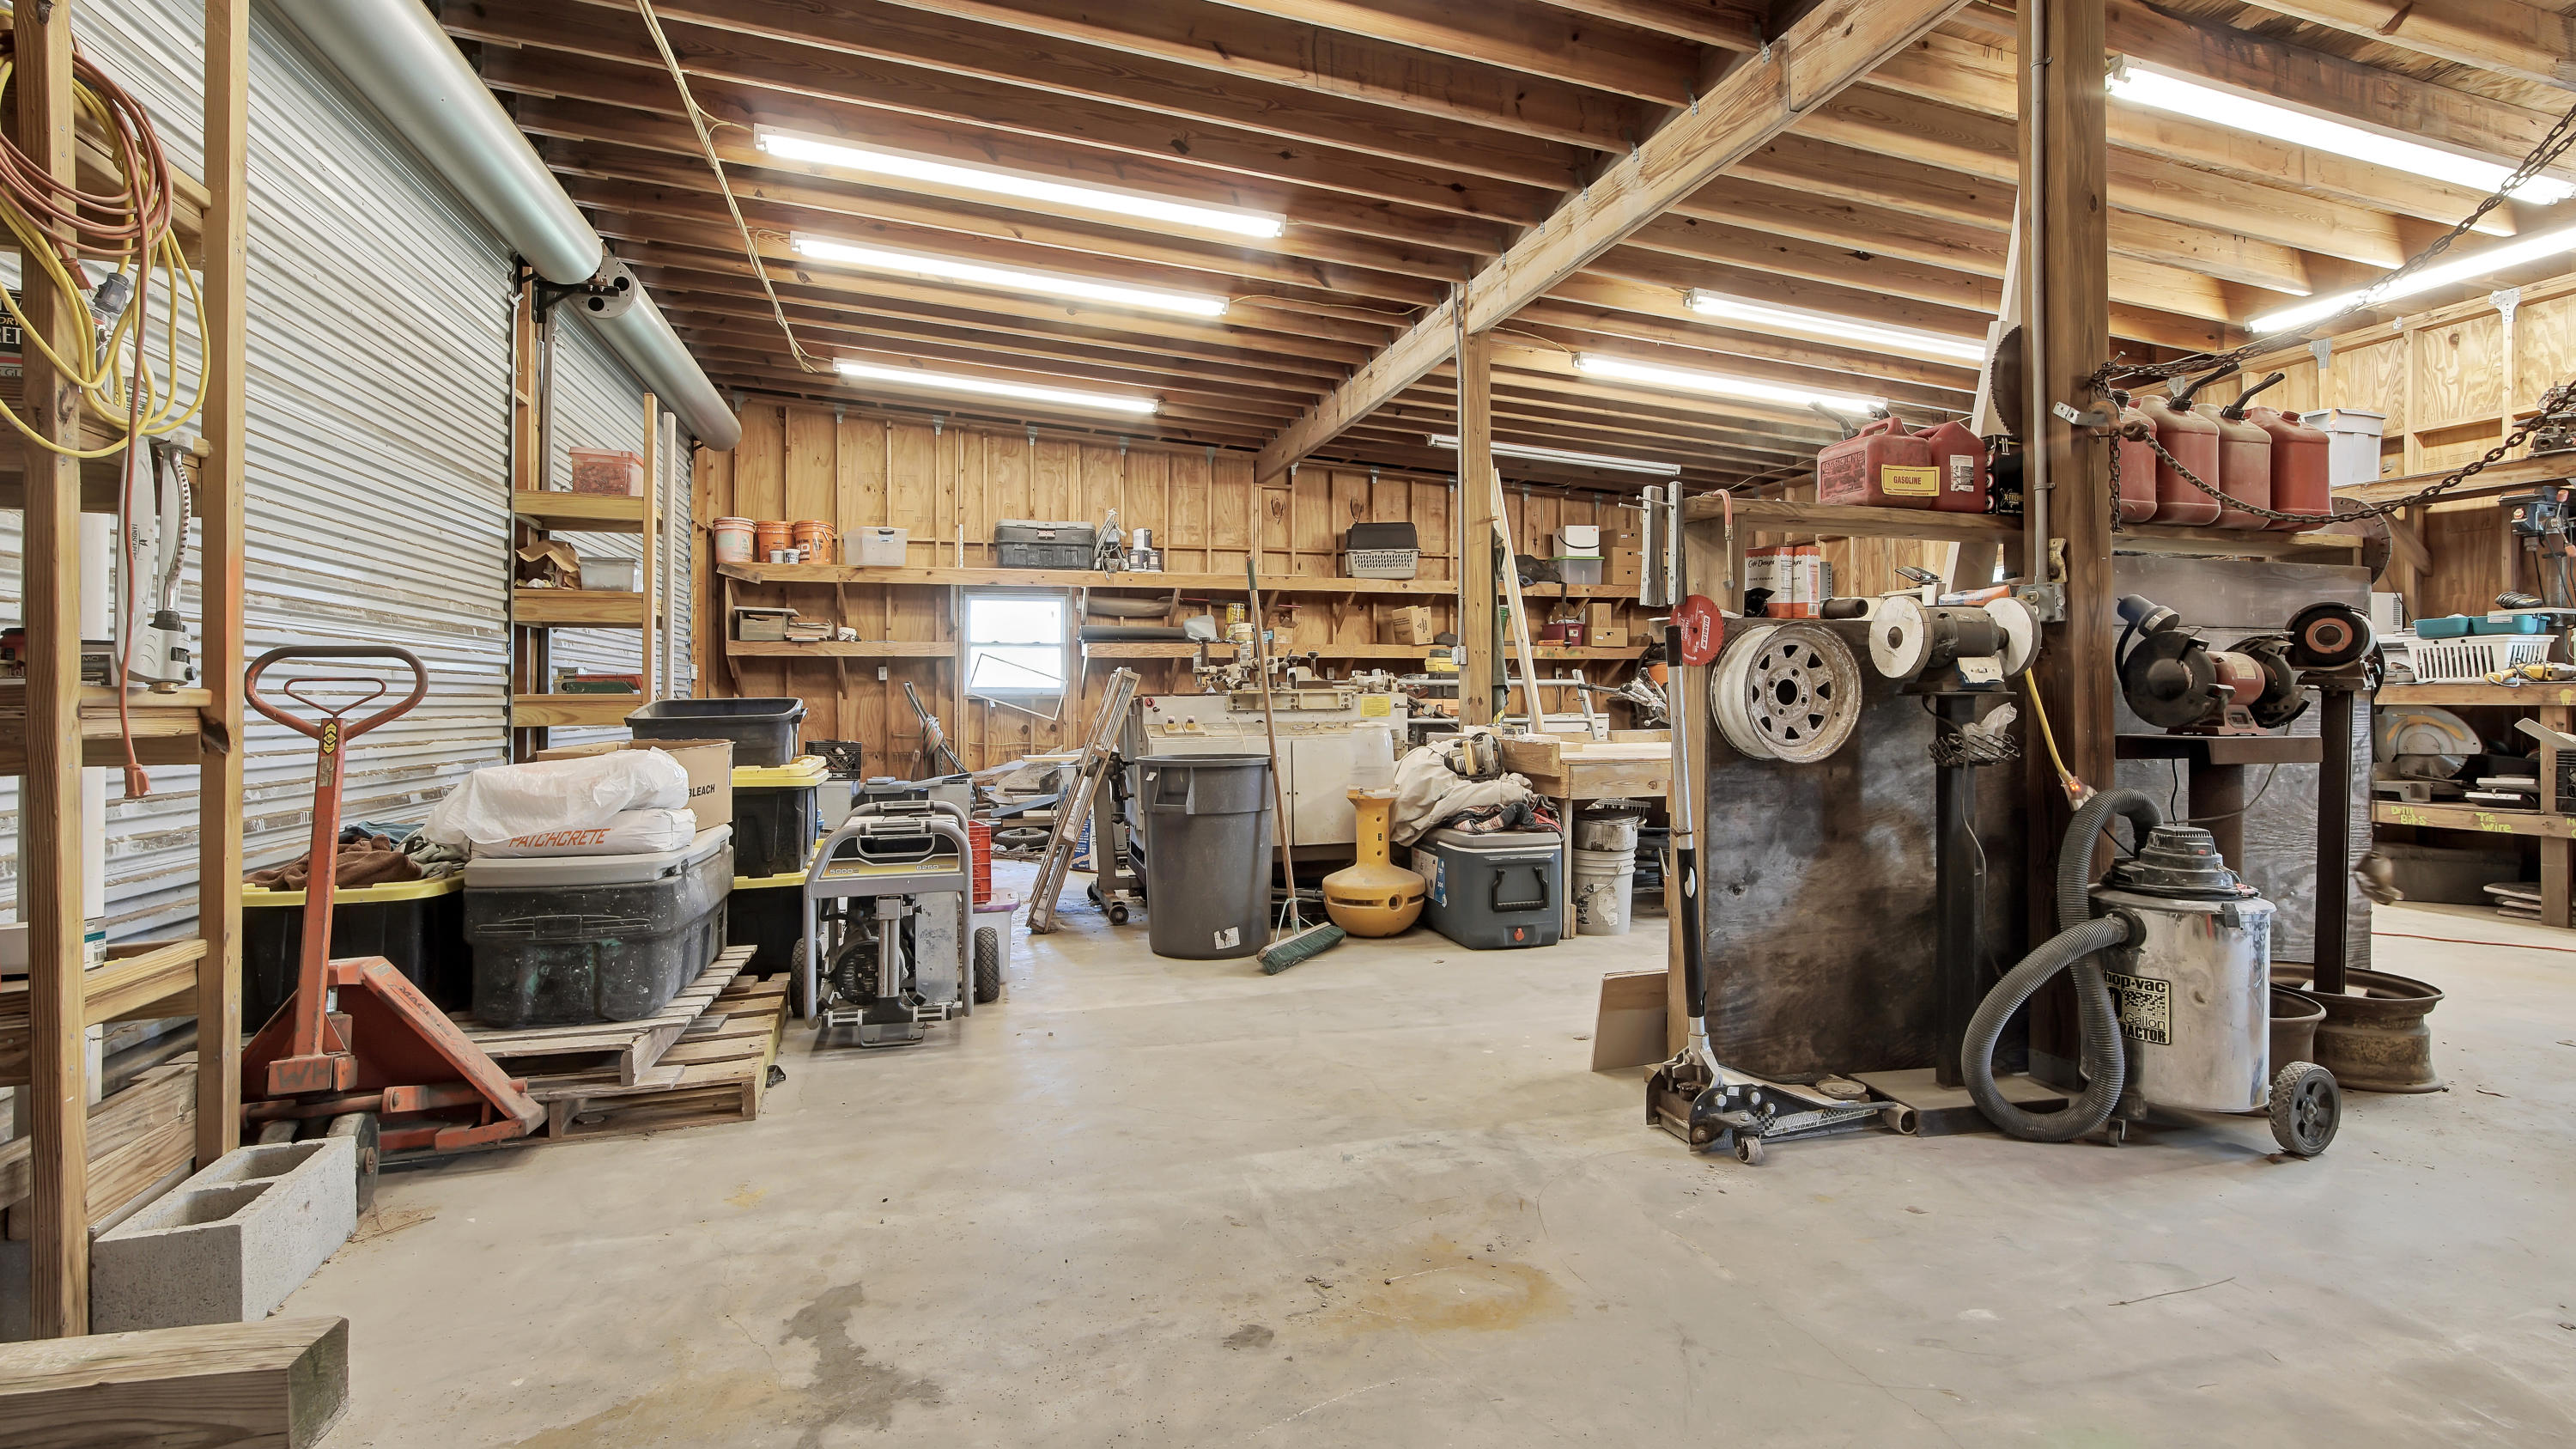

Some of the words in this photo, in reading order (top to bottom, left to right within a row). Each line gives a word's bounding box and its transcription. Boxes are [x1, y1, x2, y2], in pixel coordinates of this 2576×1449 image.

[1823, 452, 1864, 470] GASOLINE
[1893, 476, 1921, 485] GASOLINE
[2391, 806, 2414, 815] Drill
[2400, 815, 2427, 825] Bits
[2475, 812, 2496, 823] Tie
[2481, 822, 2512, 833] Wire
[2123, 1012, 2166, 1030] Gallon
